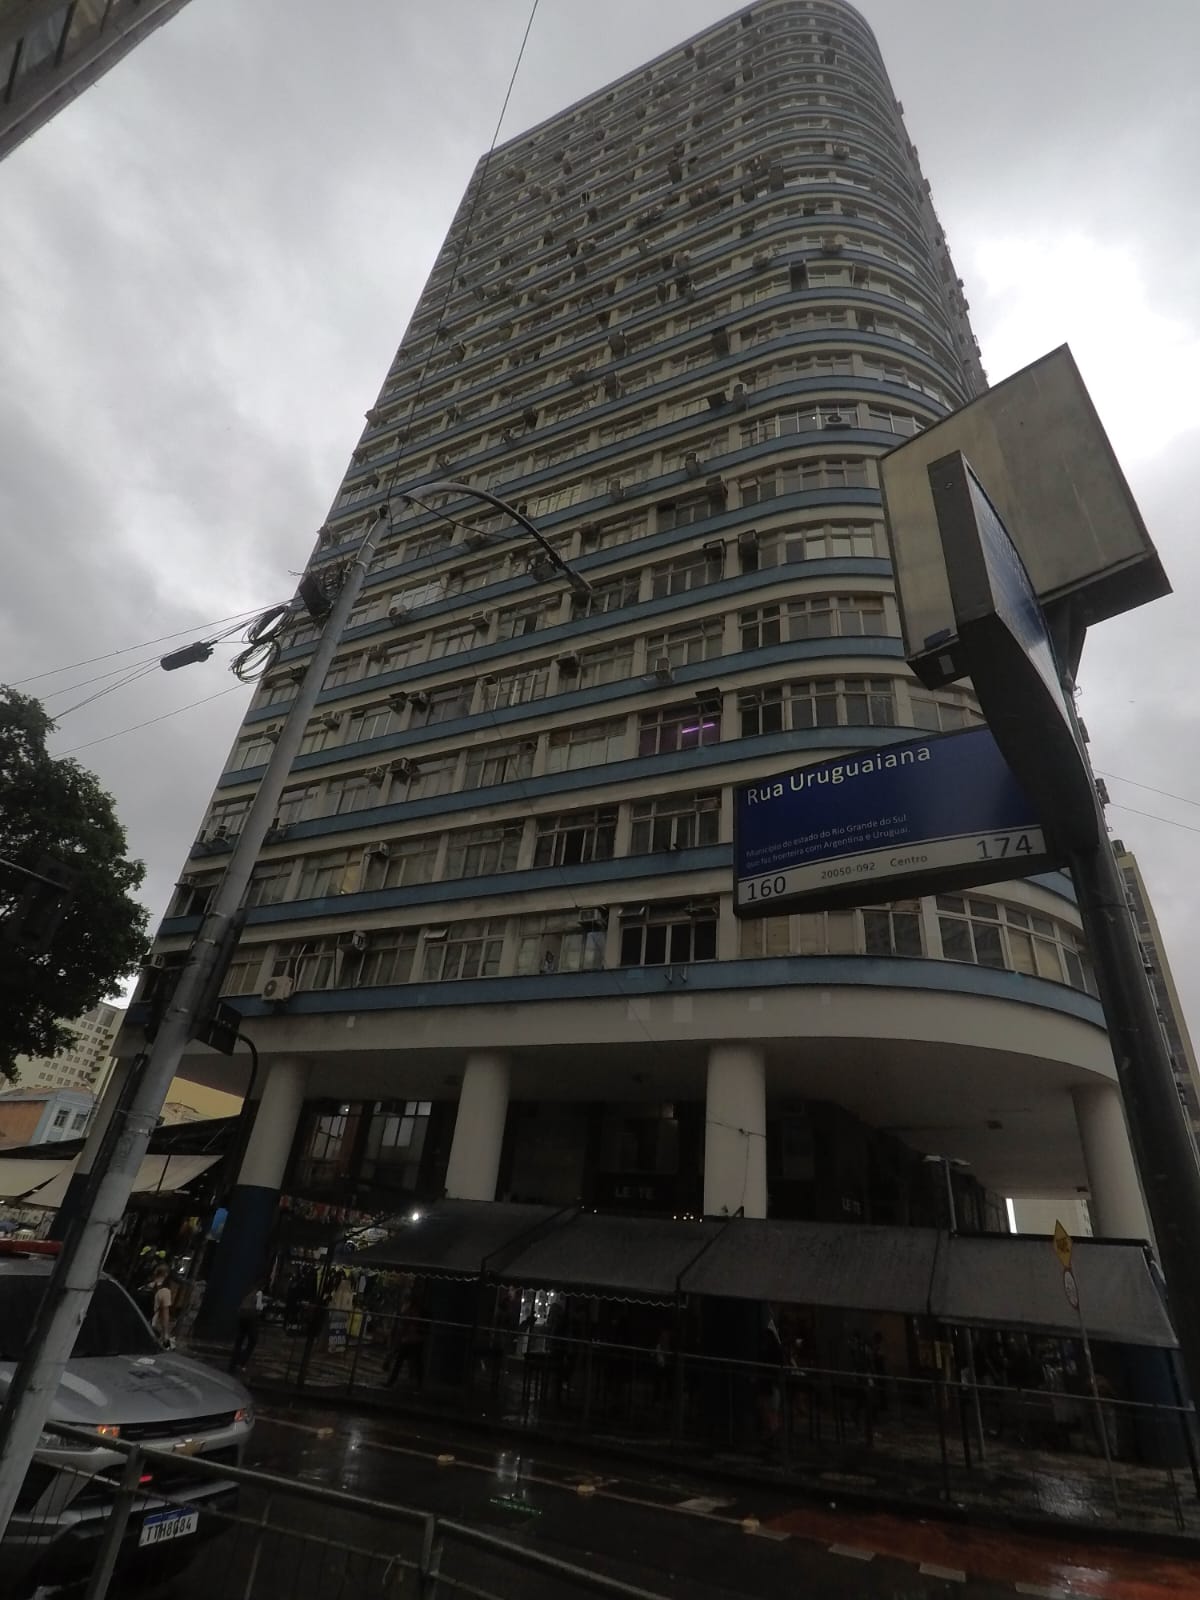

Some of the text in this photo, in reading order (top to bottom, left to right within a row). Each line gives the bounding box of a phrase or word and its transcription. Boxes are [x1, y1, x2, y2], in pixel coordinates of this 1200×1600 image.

[746, 746, 931, 806] Rua Uruguaiana
[793, 832, 819, 845] estado
[820, 828, 831, 839] do
[832, 825, 845, 837] Rio
[846, 820, 879, 834] Grande
[880, 817, 891, 826] do
[893, 813, 907, 825] Sul
[806, 844, 822, 854] com
[823, 834, 864, 849] Argentina
[747, 835, 1033, 901] 160 20050-092 Centro 174
